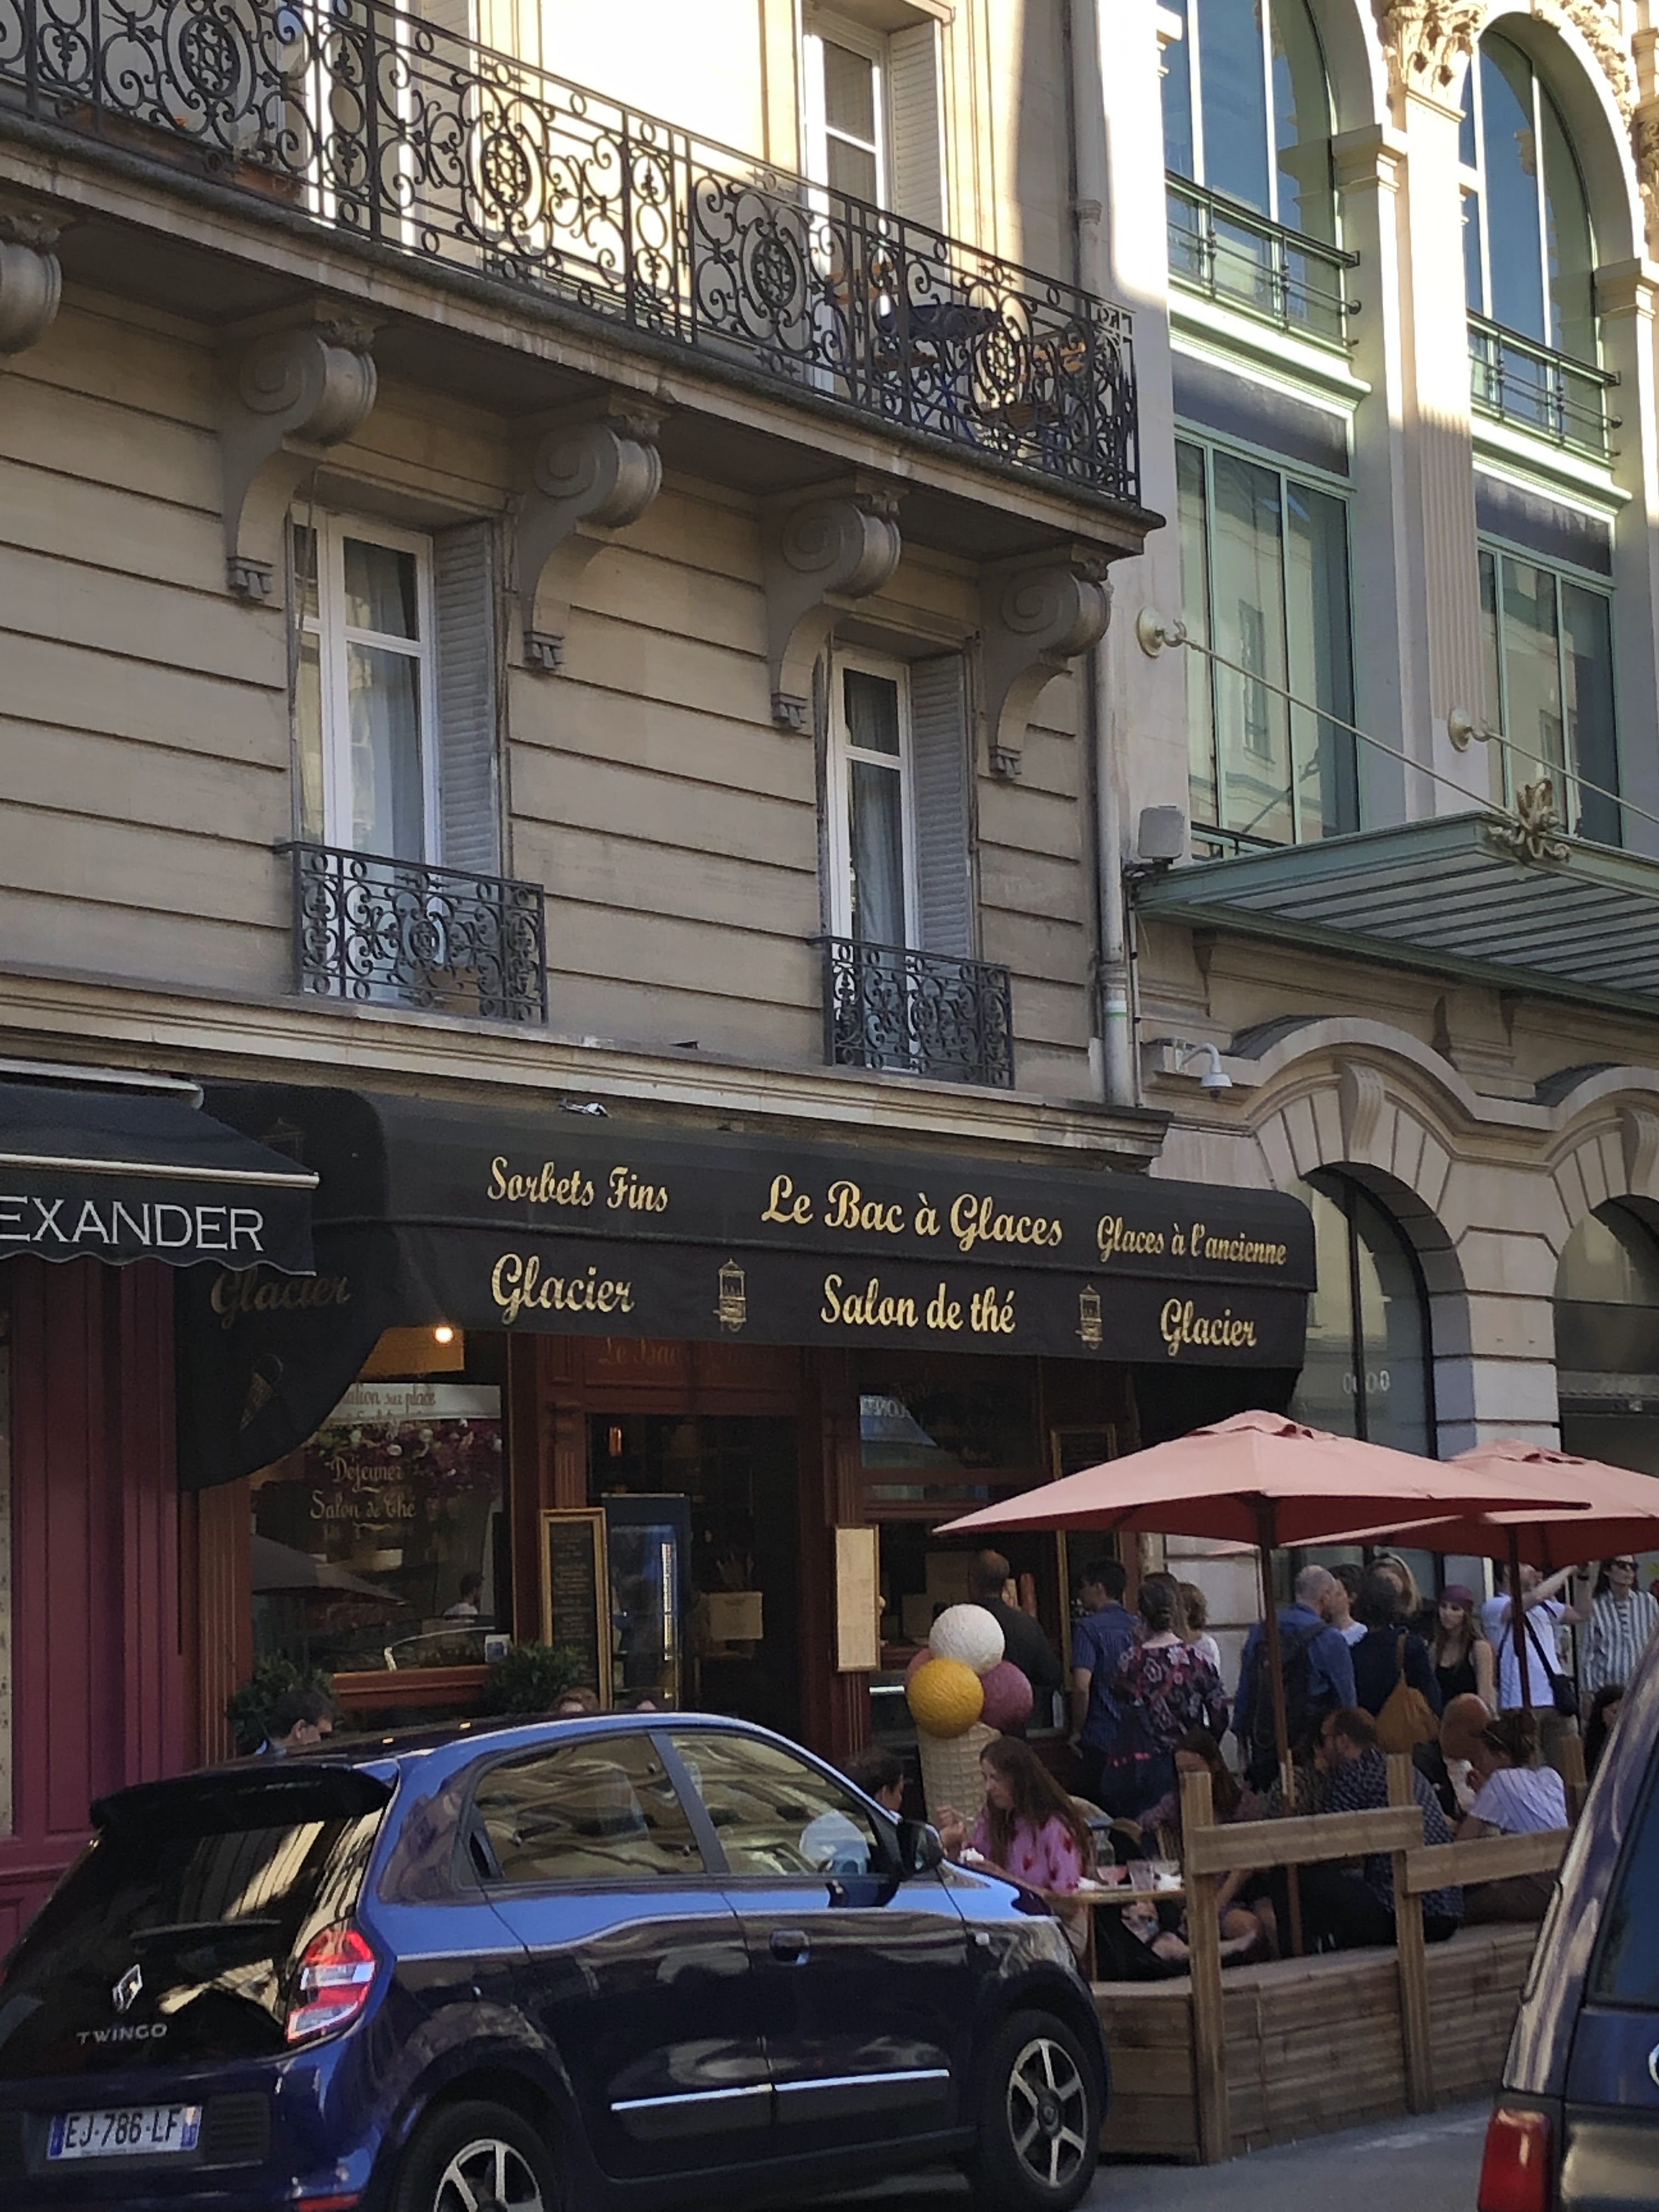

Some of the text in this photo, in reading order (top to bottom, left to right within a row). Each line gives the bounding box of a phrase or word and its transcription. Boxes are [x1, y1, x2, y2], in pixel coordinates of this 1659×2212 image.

[487, 1156, 668, 1212] Sorbets Fins
[761, 1175, 1062, 1251] Le Bac à Glaces
[1097, 1215, 1287, 1265] Glaces à l'ancienne
[210, 1267, 352, 1330] Glacier
[491, 1253, 635, 1325] Glacier
[820, 1273, 1015, 1333] Salon de thé
[1160, 1298, 1257, 1357] Glacier
[309, 1489, 360, 1520] Salon
[76, 2023, 167, 2045] TWINGO
[65, 2108, 182, 2149] EJ-786-LF
